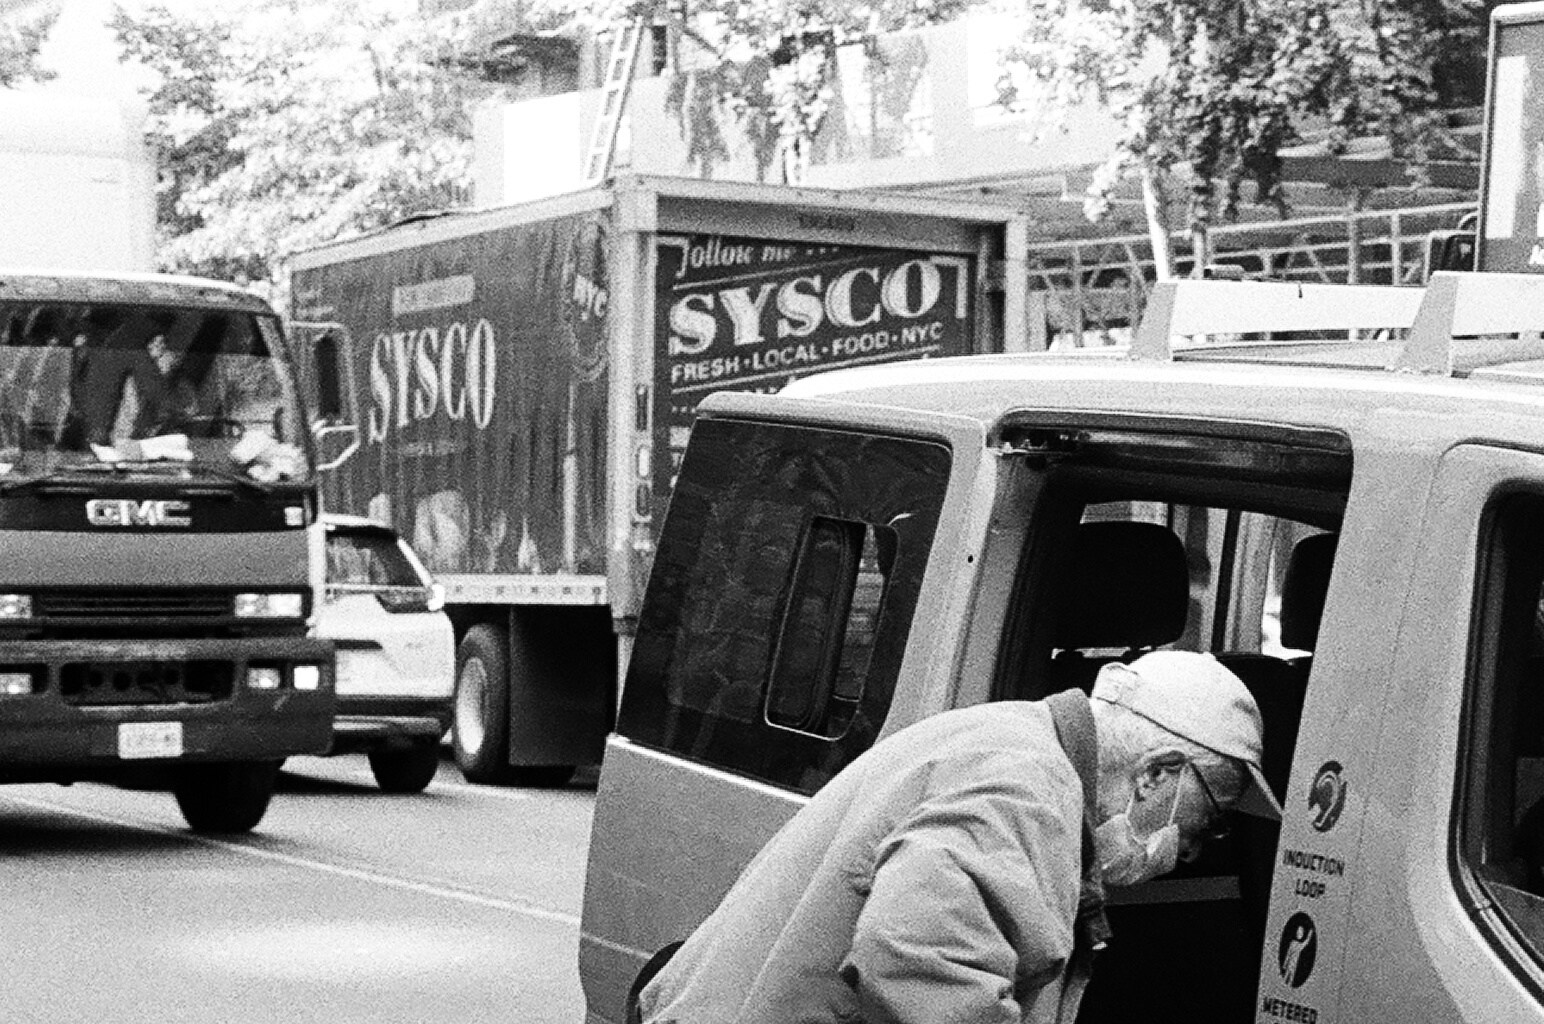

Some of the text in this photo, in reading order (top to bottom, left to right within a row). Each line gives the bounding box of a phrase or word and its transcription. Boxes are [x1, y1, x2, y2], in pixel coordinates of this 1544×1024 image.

[667, 259, 941, 355] SYSCO
[671, 321, 943, 384] FRESH LOCAL FOOD NYC
[367, 318, 496, 445] SYSCO
[85, 499, 192, 526] GMC
[1283, 850, 1345, 877] INDUCTION
[1295, 879, 1326, 899] LOOP
